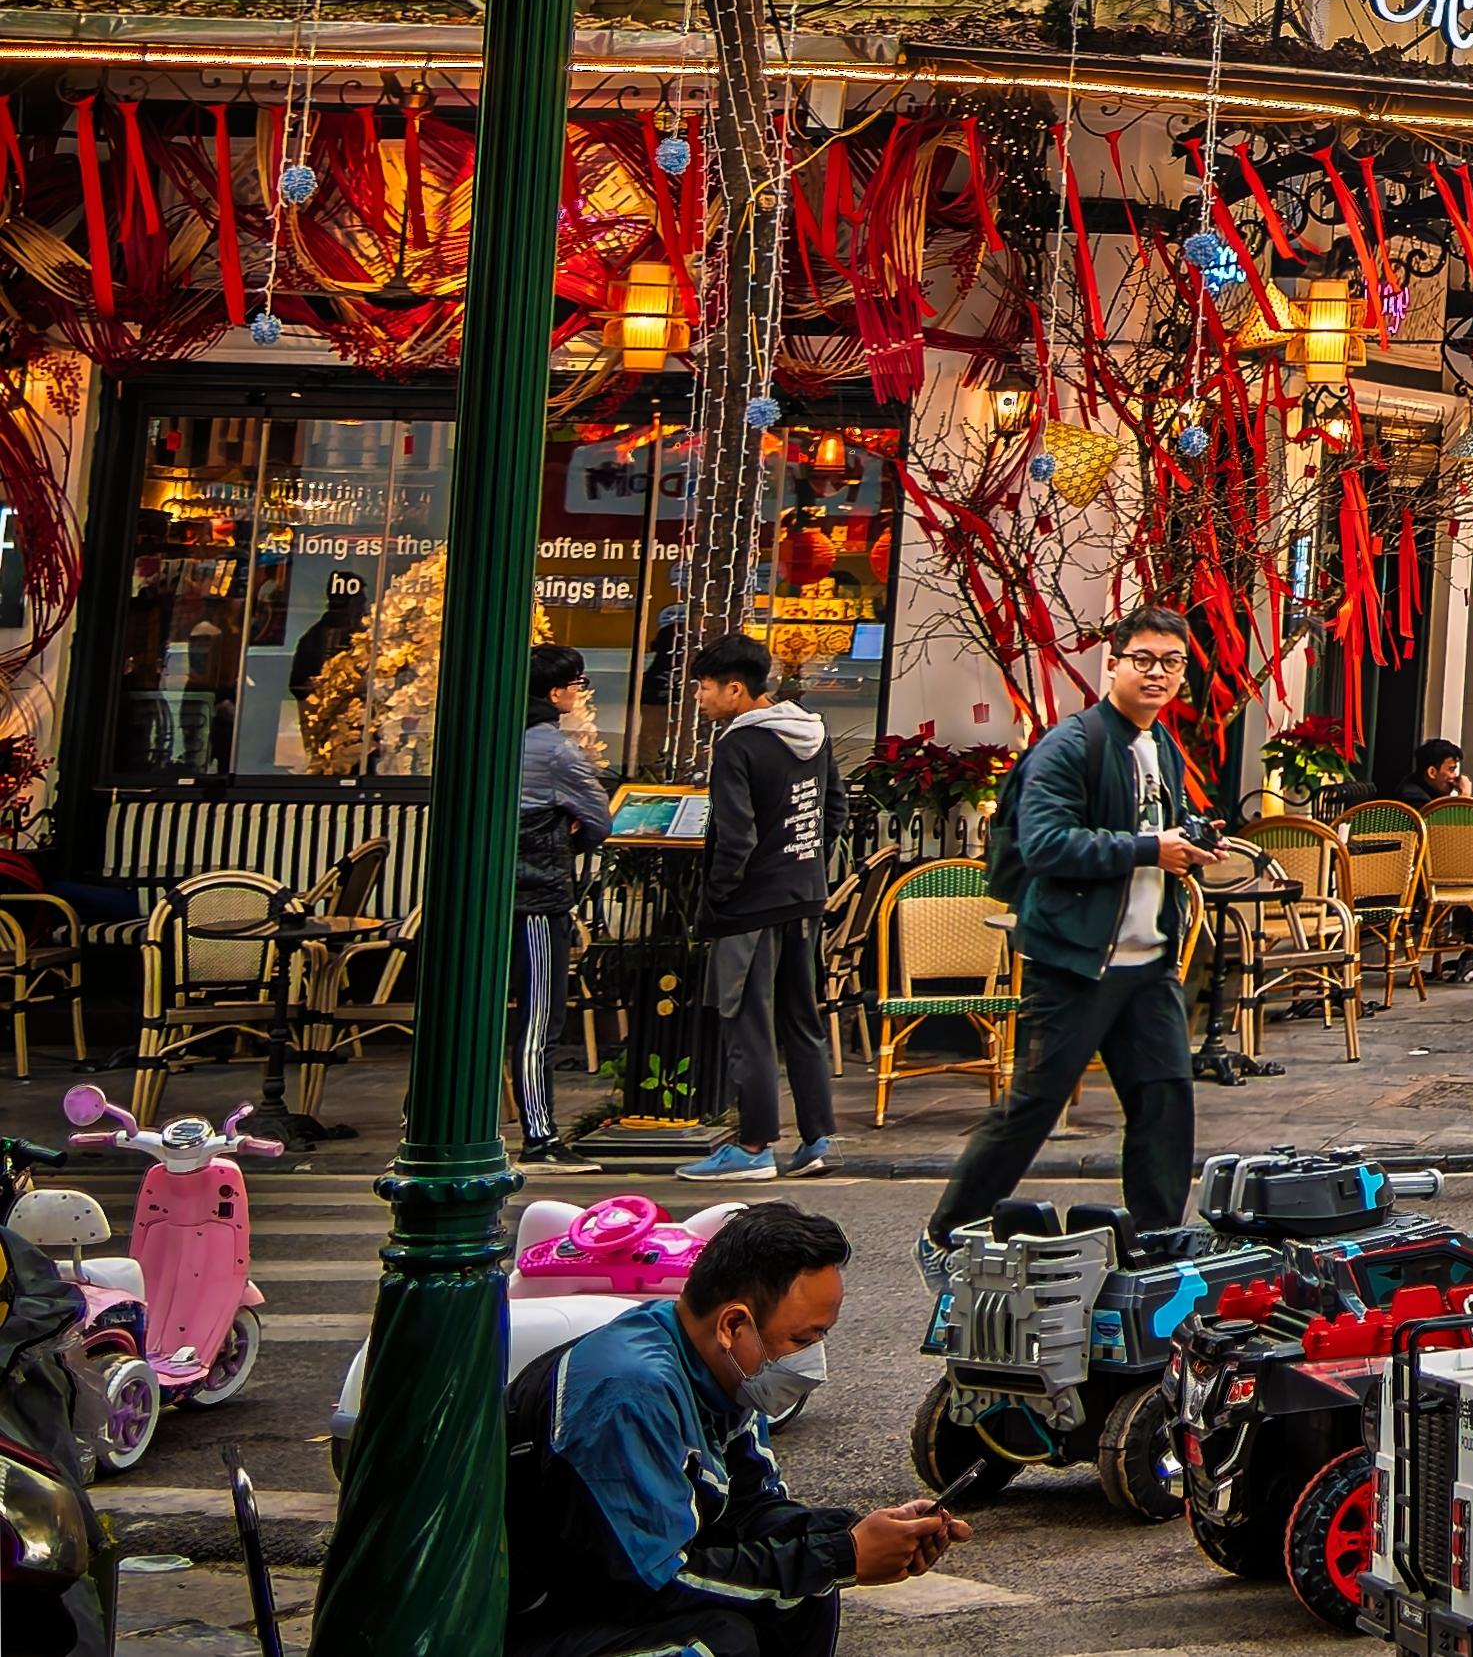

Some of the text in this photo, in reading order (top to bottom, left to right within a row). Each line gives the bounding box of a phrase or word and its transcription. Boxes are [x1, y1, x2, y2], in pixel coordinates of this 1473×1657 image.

[299, 533, 348, 561] long
[355, 537, 383, 556] as
[602, 537, 624, 561] in
[601, 577, 634, 600] be.
